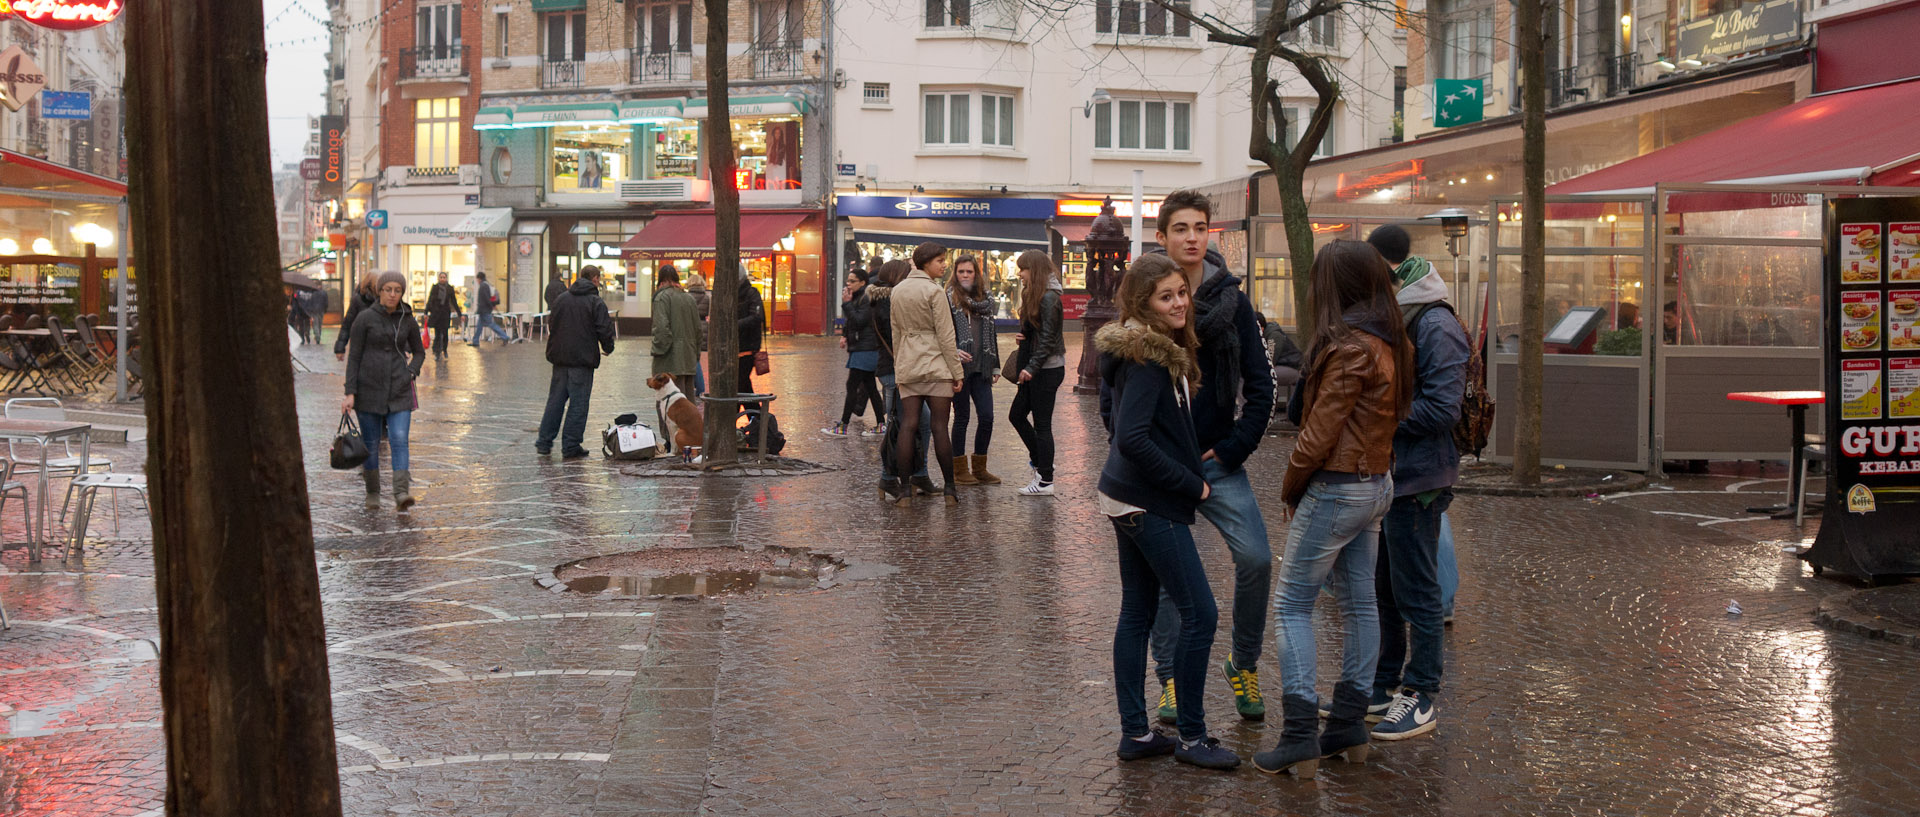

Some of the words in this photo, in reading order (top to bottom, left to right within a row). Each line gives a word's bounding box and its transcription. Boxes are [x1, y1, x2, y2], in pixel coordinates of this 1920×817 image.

[1711, 14, 1728, 39] Le
[1711, 42, 1733, 54] cuisine
[1742, 34, 1770, 51] fromage
[53, 107, 89, 116] carterie
[542, 112, 577, 121] FEMININ
[624, 108, 669, 118] COIFFURE
[325, 129, 344, 182] Orange
[931, 202, 990, 210] BIGSTAR
[403, 226, 417, 234] Club
[418, 227, 449, 235] Bouygues
[40, 265, 79, 278] PRESSIONS
[1859, 461, 1920, 474] KEBAB
